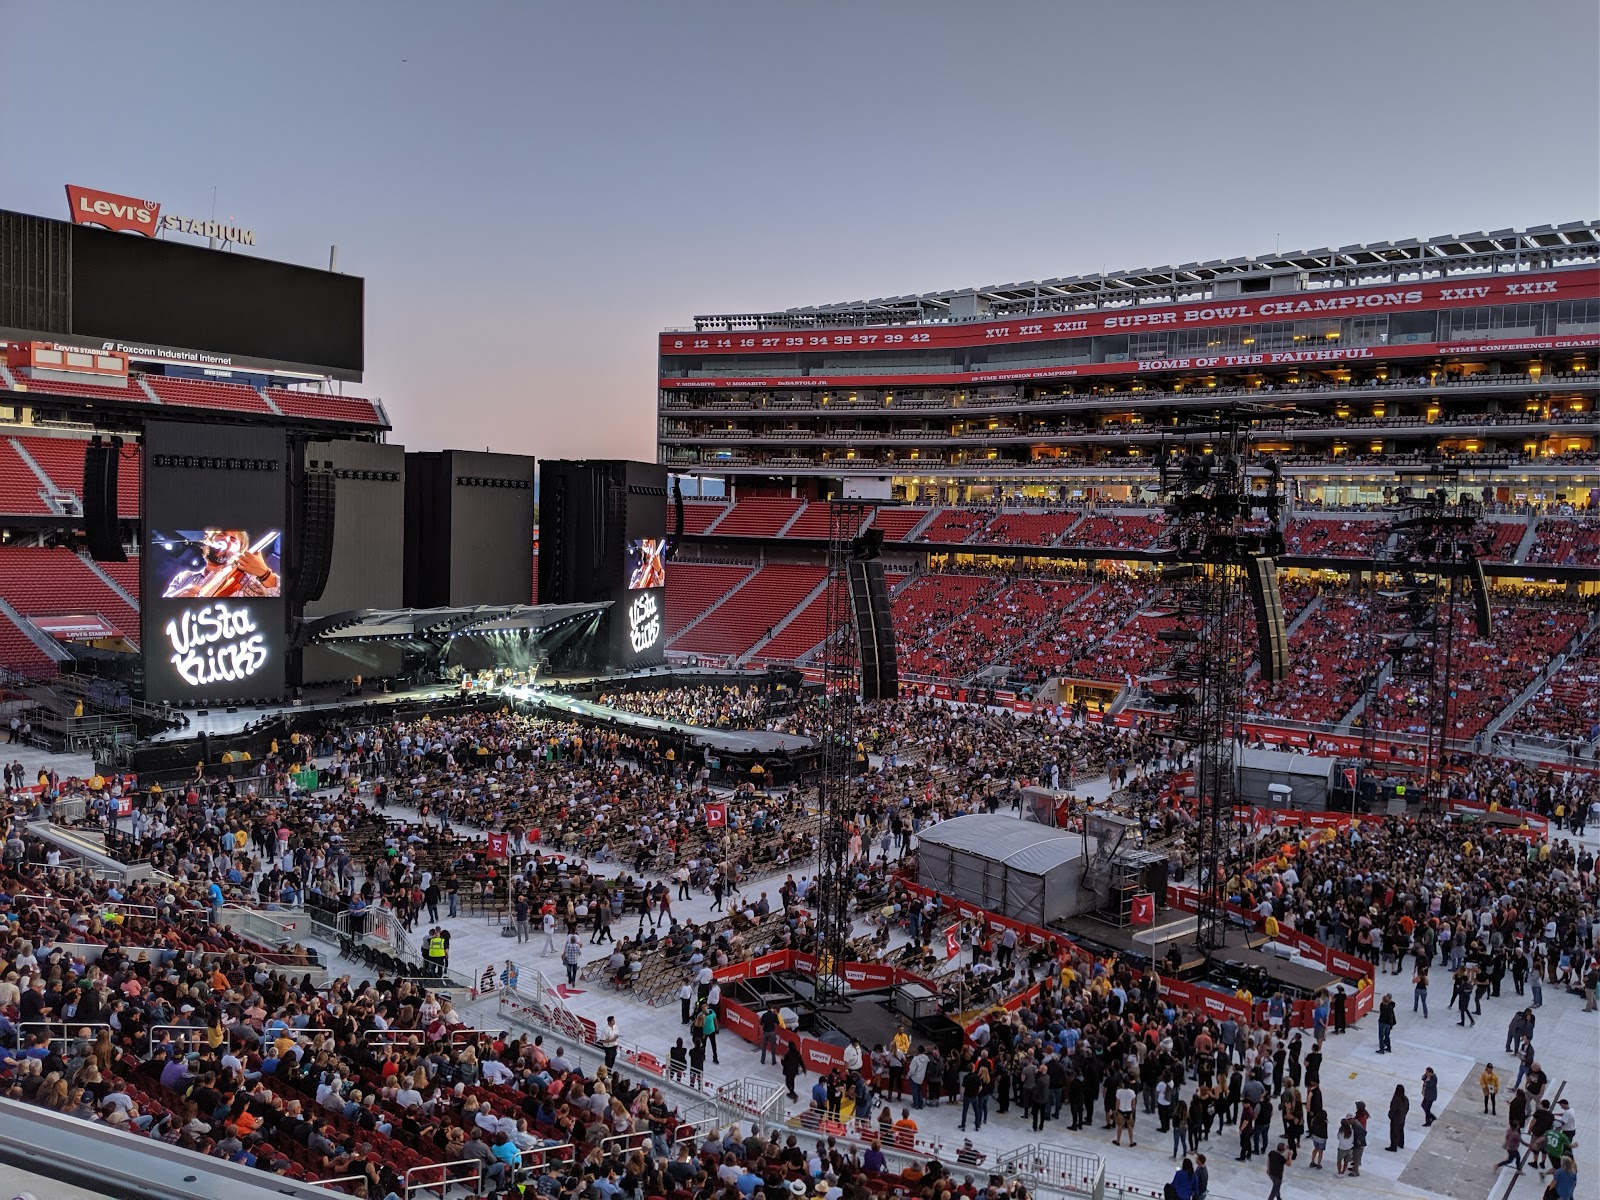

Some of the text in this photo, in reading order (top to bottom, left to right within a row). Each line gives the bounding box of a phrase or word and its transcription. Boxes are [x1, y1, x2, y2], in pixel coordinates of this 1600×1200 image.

[80, 197, 151, 224] Levi's
[164, 215, 256, 246] STADIUM
[986, 328, 1009, 338] XVI
[1019, 325, 1042, 335] XIX
[1104, 312, 1177, 328] SUPER
[1183, 306, 1253, 321] BOWL
[1259, 291, 1423, 316] CHAMPIONS
[1439, 286, 1490, 301] XXIV
[1506, 281, 1557, 296] XXIX
[674, 333, 930, 348] 8 12 14 16 27 33 34 35 37 39 42
[1480, 342, 1552, 352] CONFERENCE
[1555, 339, 1600, 349] CHAMP
[80, 347, 109, 356] STADIUM
[117, 343, 155, 356] Foxconn
[157, 349, 198, 361] Industrial
[199, 354, 231, 365] Internet
[1138, 348, 1374, 371] HOME OF THE FAITHFUL
[1033, 370, 1077, 378] CHAMPIONS
[710, 810, 722, 821] D
